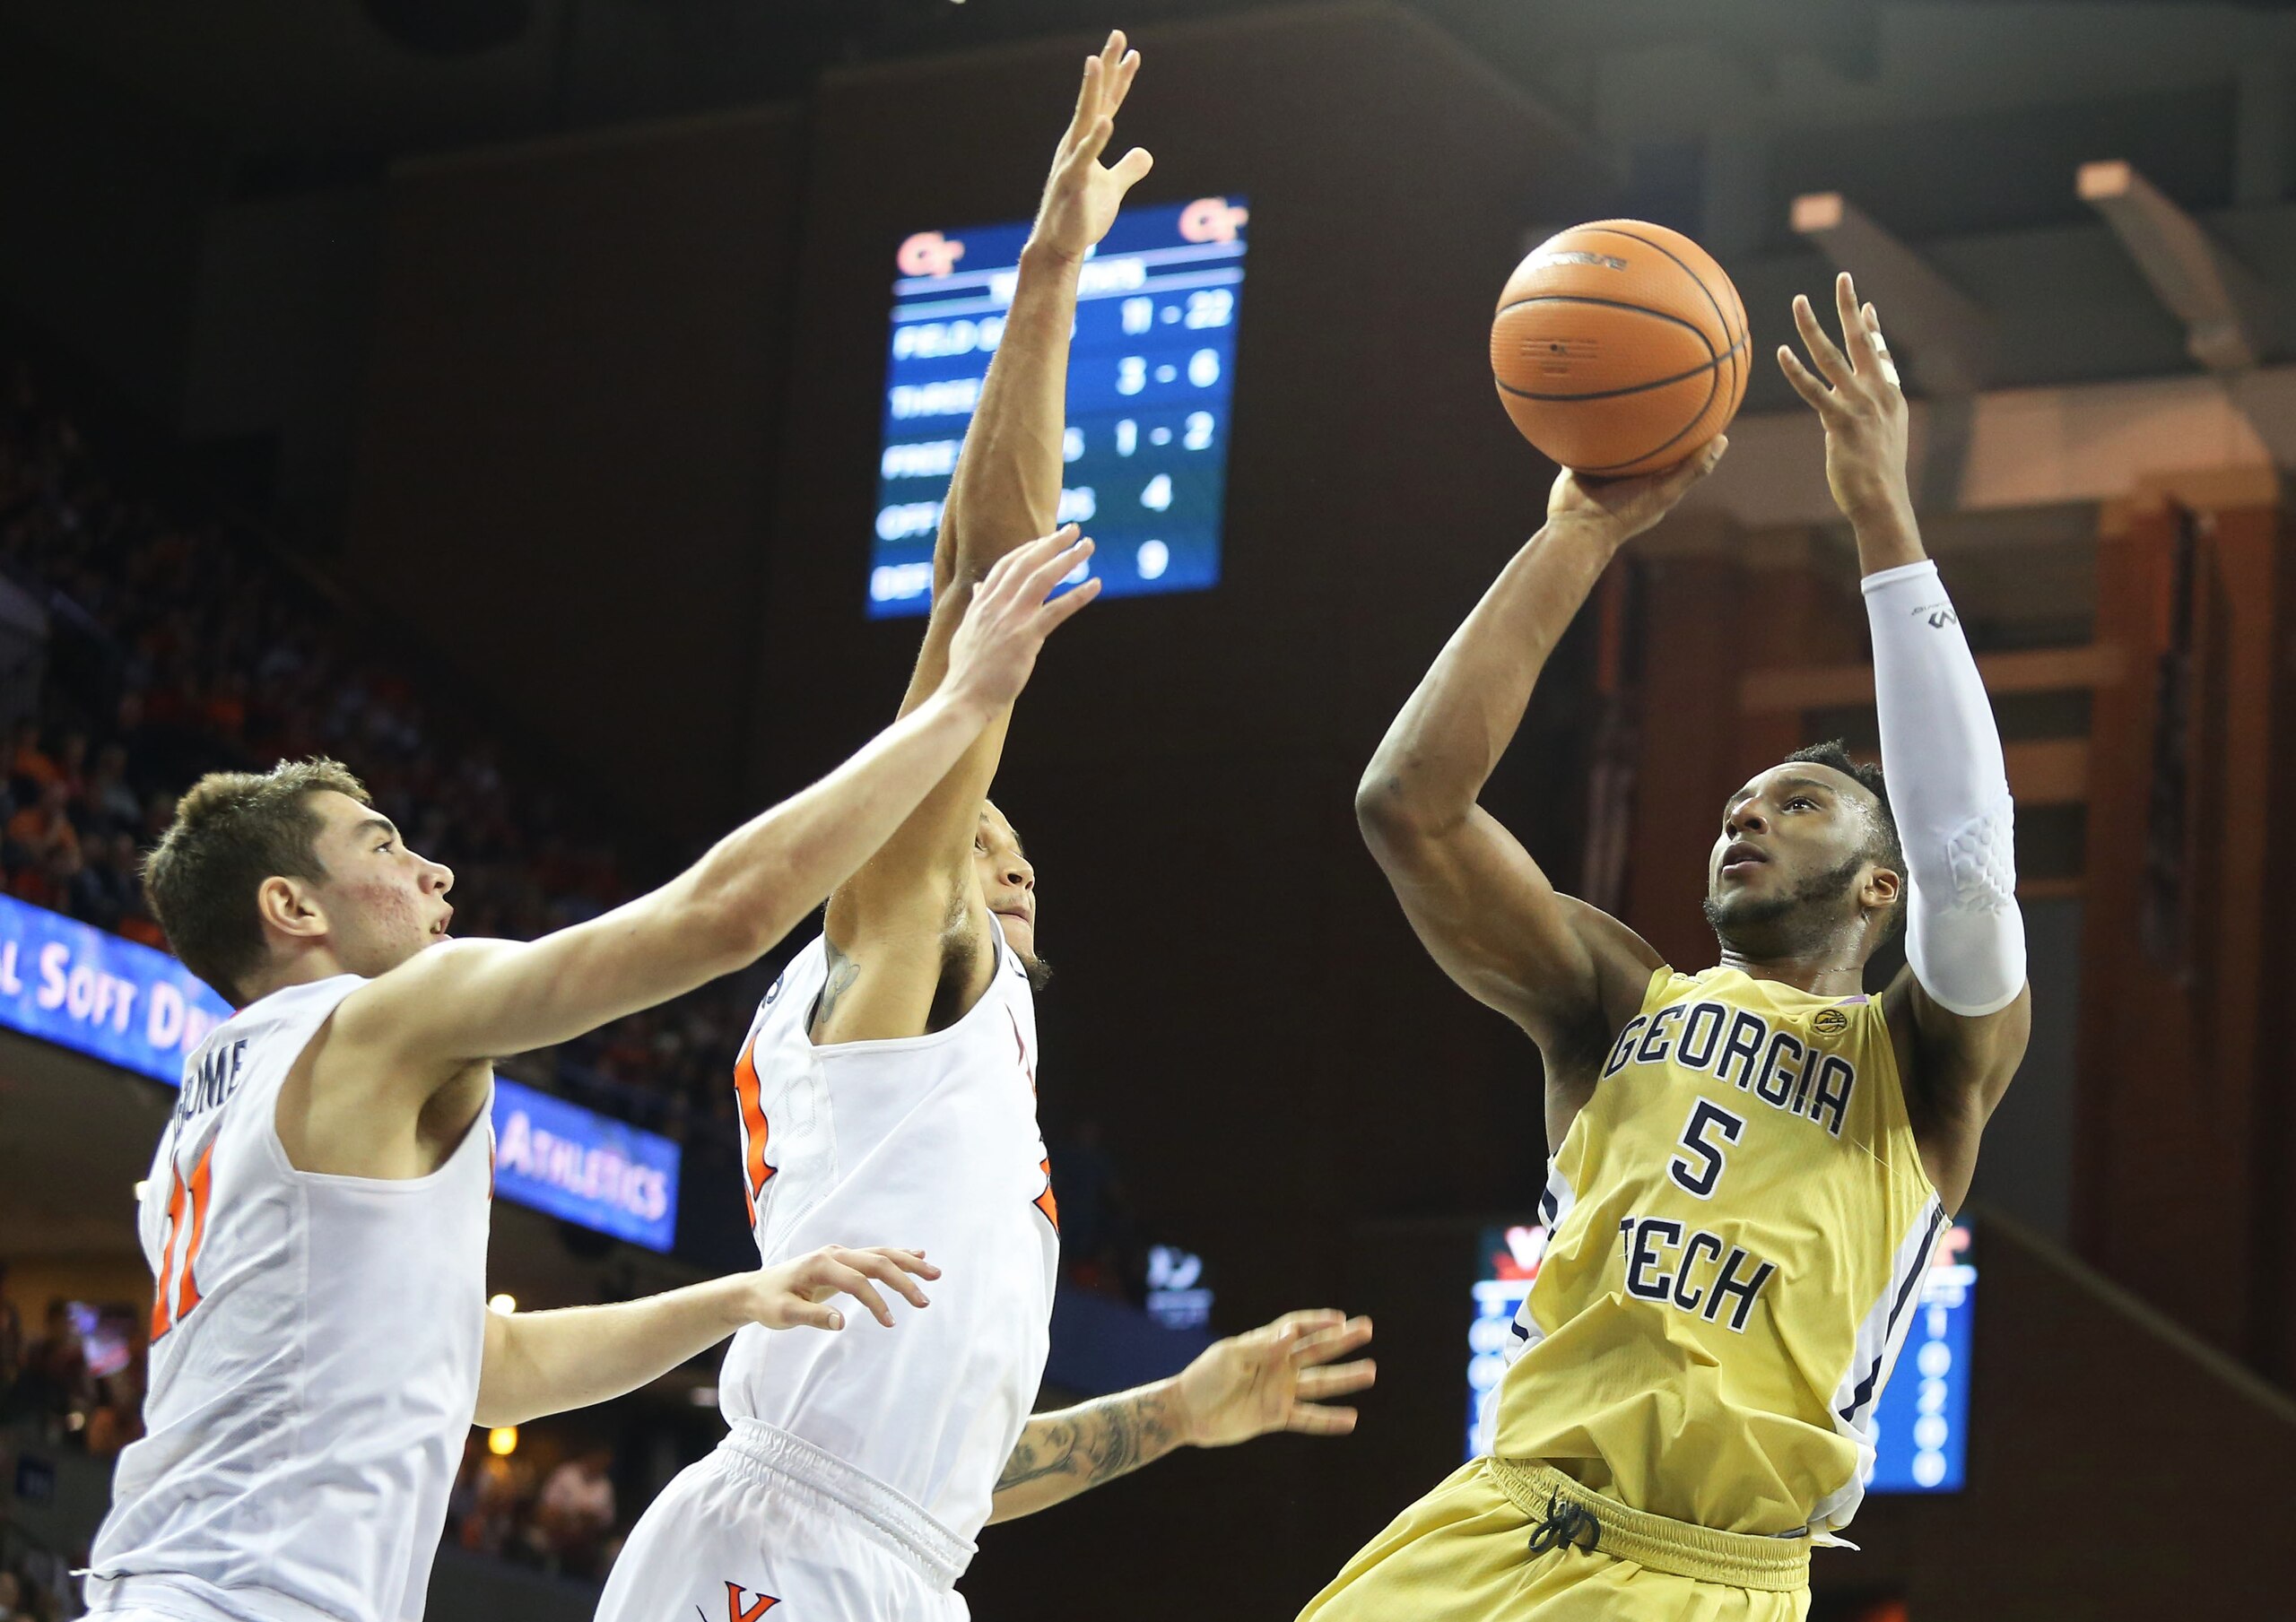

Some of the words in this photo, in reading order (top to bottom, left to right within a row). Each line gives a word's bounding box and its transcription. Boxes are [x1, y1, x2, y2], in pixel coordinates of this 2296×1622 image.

[1116, 418, 1137, 457] 1
[1183, 411, 1215, 451] 2
[1141, 473, 1174, 511] 4
[38, 942, 137, 1035] SOFT
[1604, 999, 1857, 1140] GEORGIA
[1666, 1096, 1747, 1201] 5
[150, 1125, 222, 1342] 11
[1619, 1216, 1779, 1335] TECH
